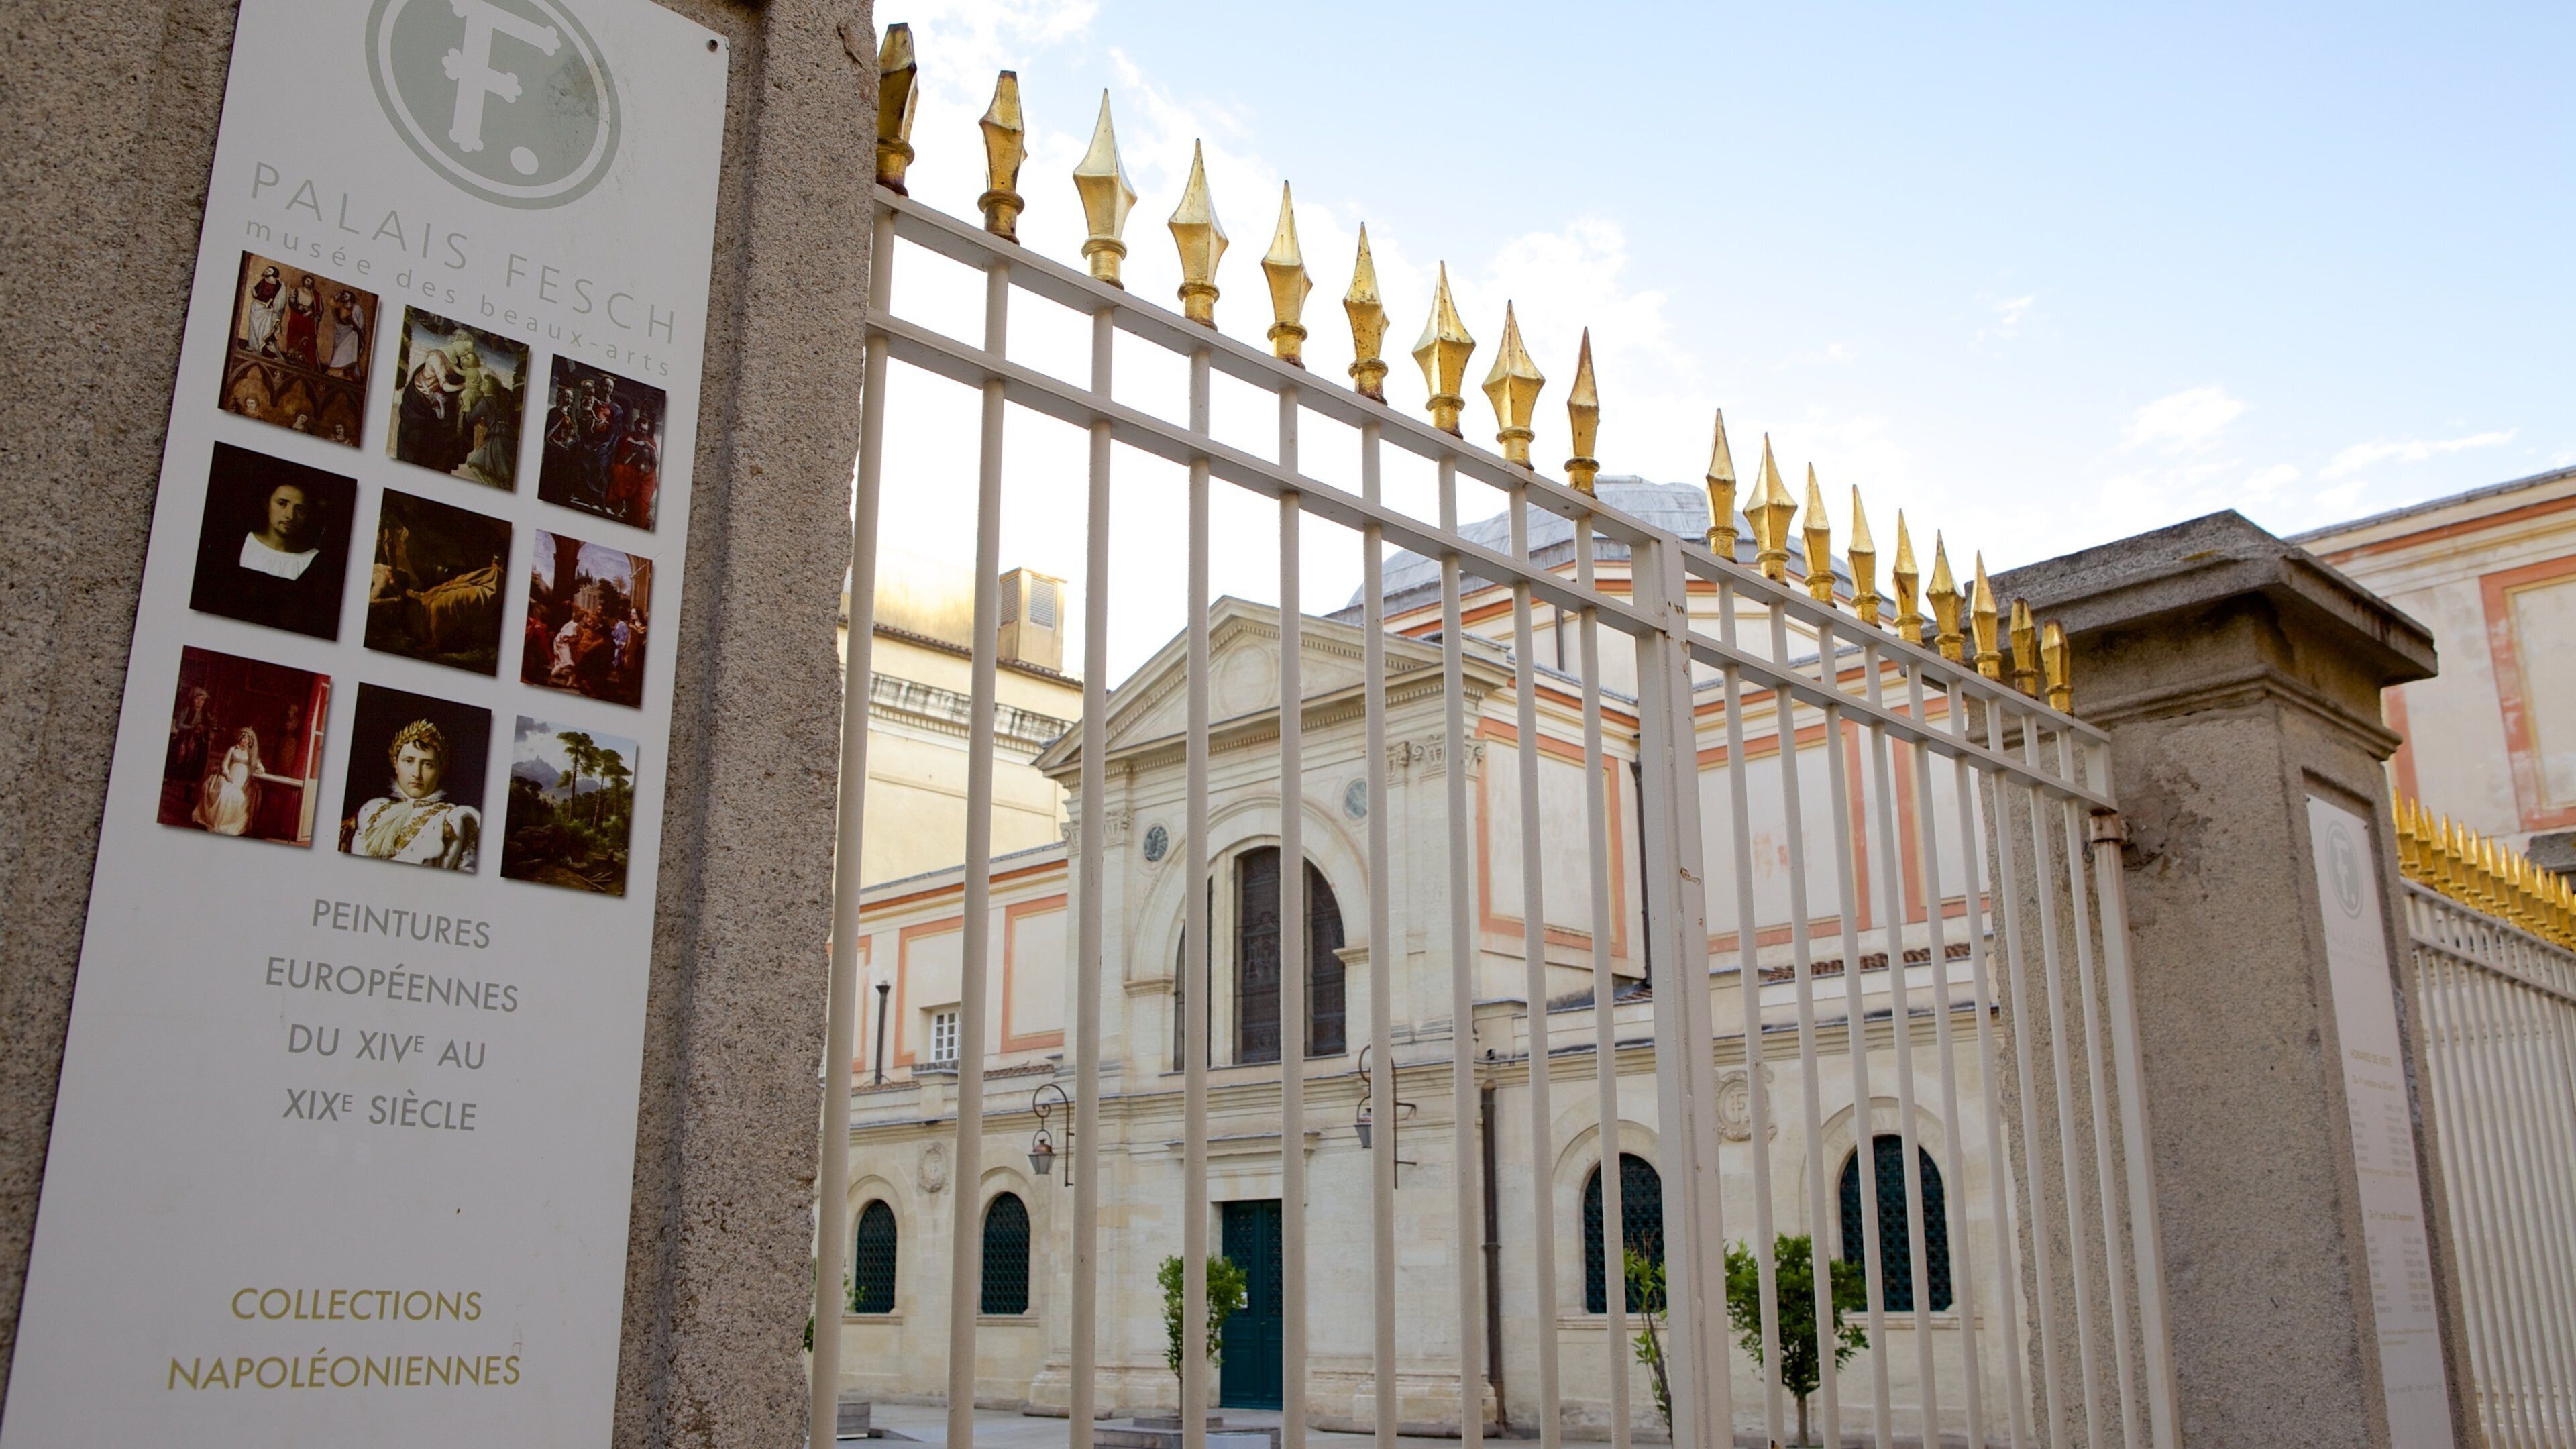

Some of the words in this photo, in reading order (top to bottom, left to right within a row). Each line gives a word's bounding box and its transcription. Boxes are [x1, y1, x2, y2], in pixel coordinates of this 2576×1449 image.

[252, 162, 468, 270] PALAIS
[506, 253, 674, 344] FESCH
[246, 220, 371, 276] musée
[396, 269, 455, 304] des
[480, 294, 668, 376] beaux-arts
[313, 898, 490, 949] PEINTURES
[266, 956, 519, 1013] EUROPÉENNES
[288, 1024, 340, 1057] DU
[437, 1039, 486, 1071] AU
[368, 1089, 477, 1132] SIÈCLE
[231, 1287, 482, 1322] COLLECTIONS
[167, 1346, 521, 1391] NAPOLÉONIENNES
